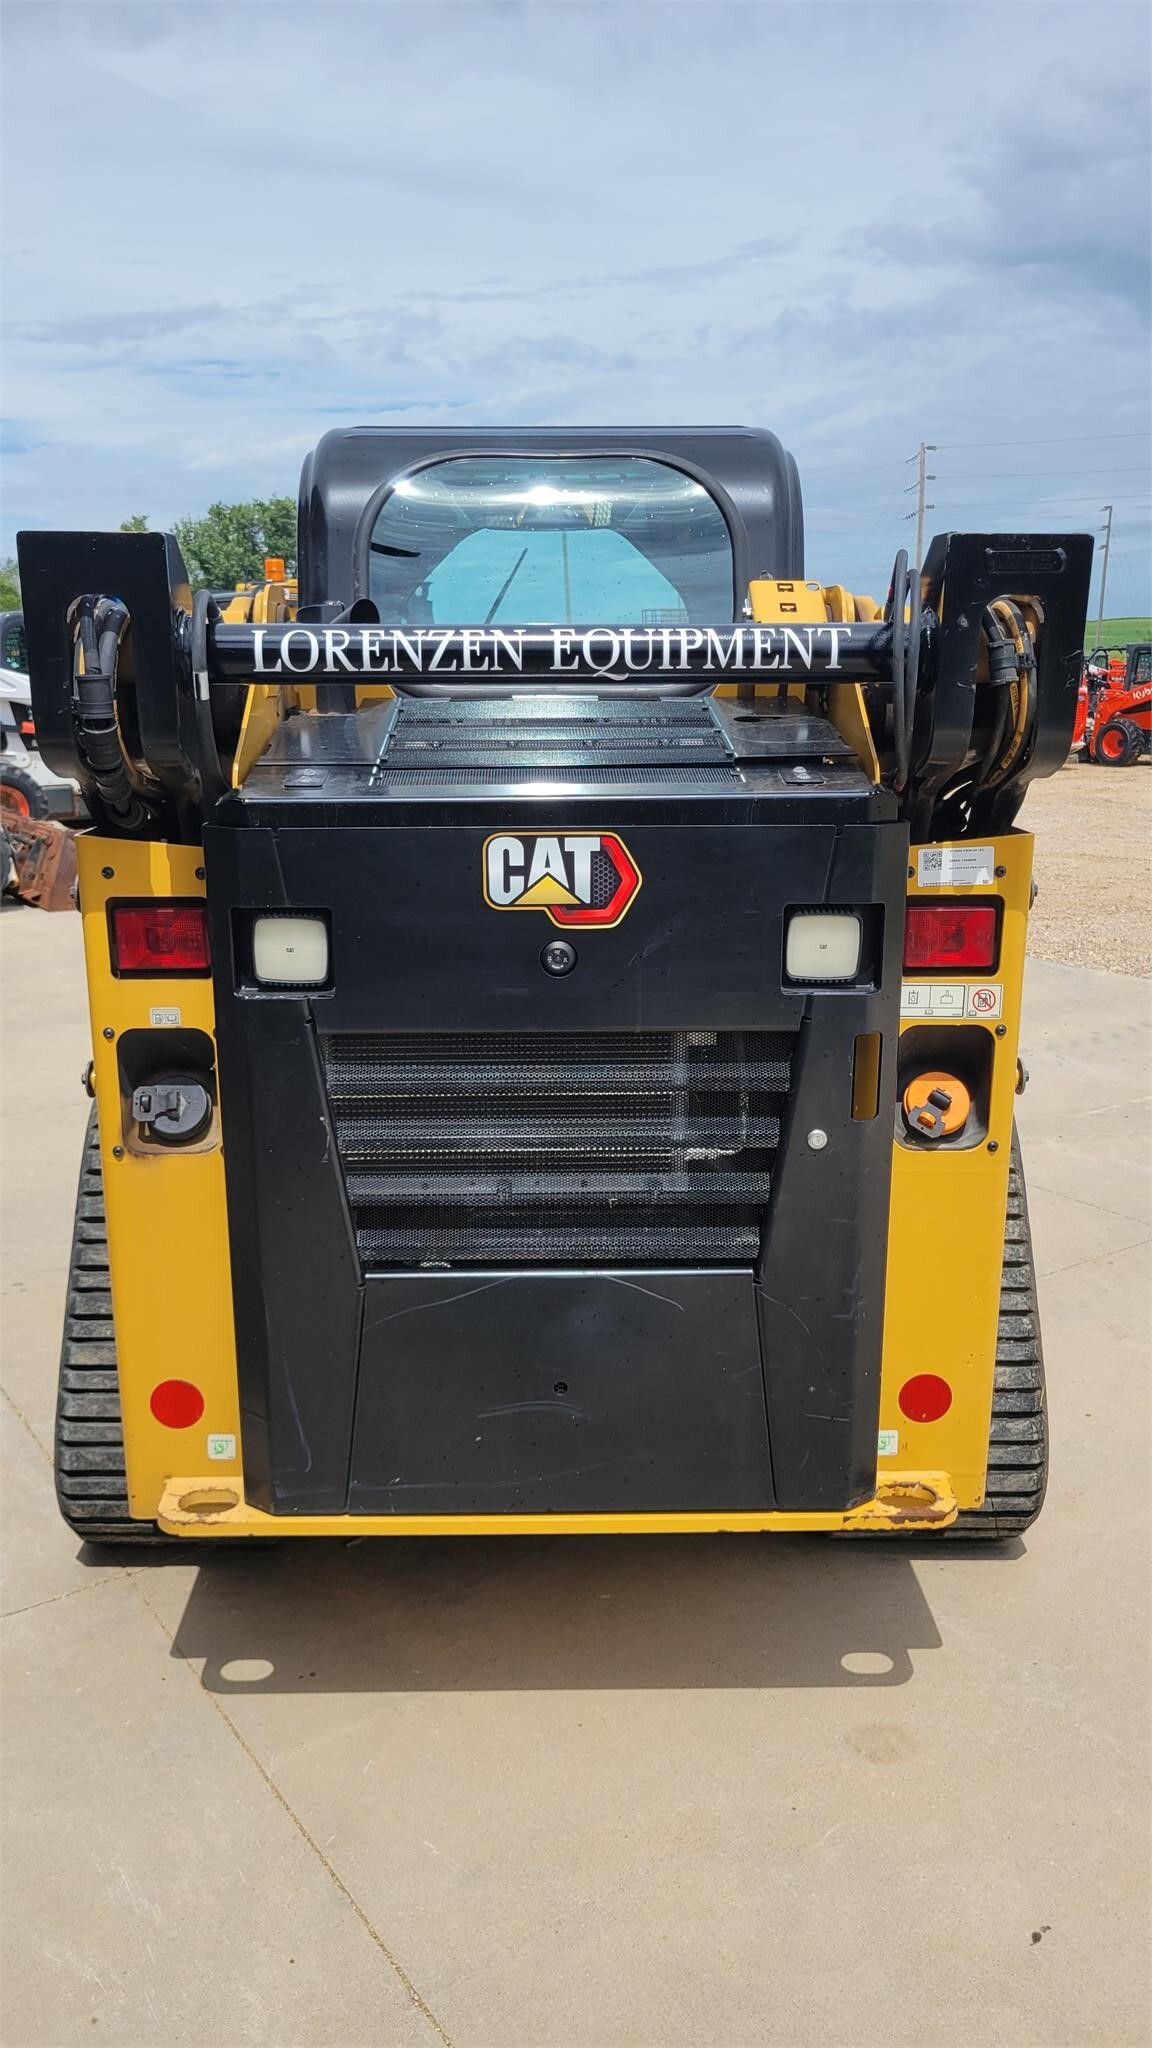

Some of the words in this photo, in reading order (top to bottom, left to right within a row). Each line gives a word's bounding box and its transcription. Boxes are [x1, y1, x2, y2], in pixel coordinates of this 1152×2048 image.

[251, 629, 526, 672] LORENZEN
[549, 627, 852, 681] EQUIPMENT
[1132, 687, 1152, 700] Kub
[487, 836, 601, 905] CAT
